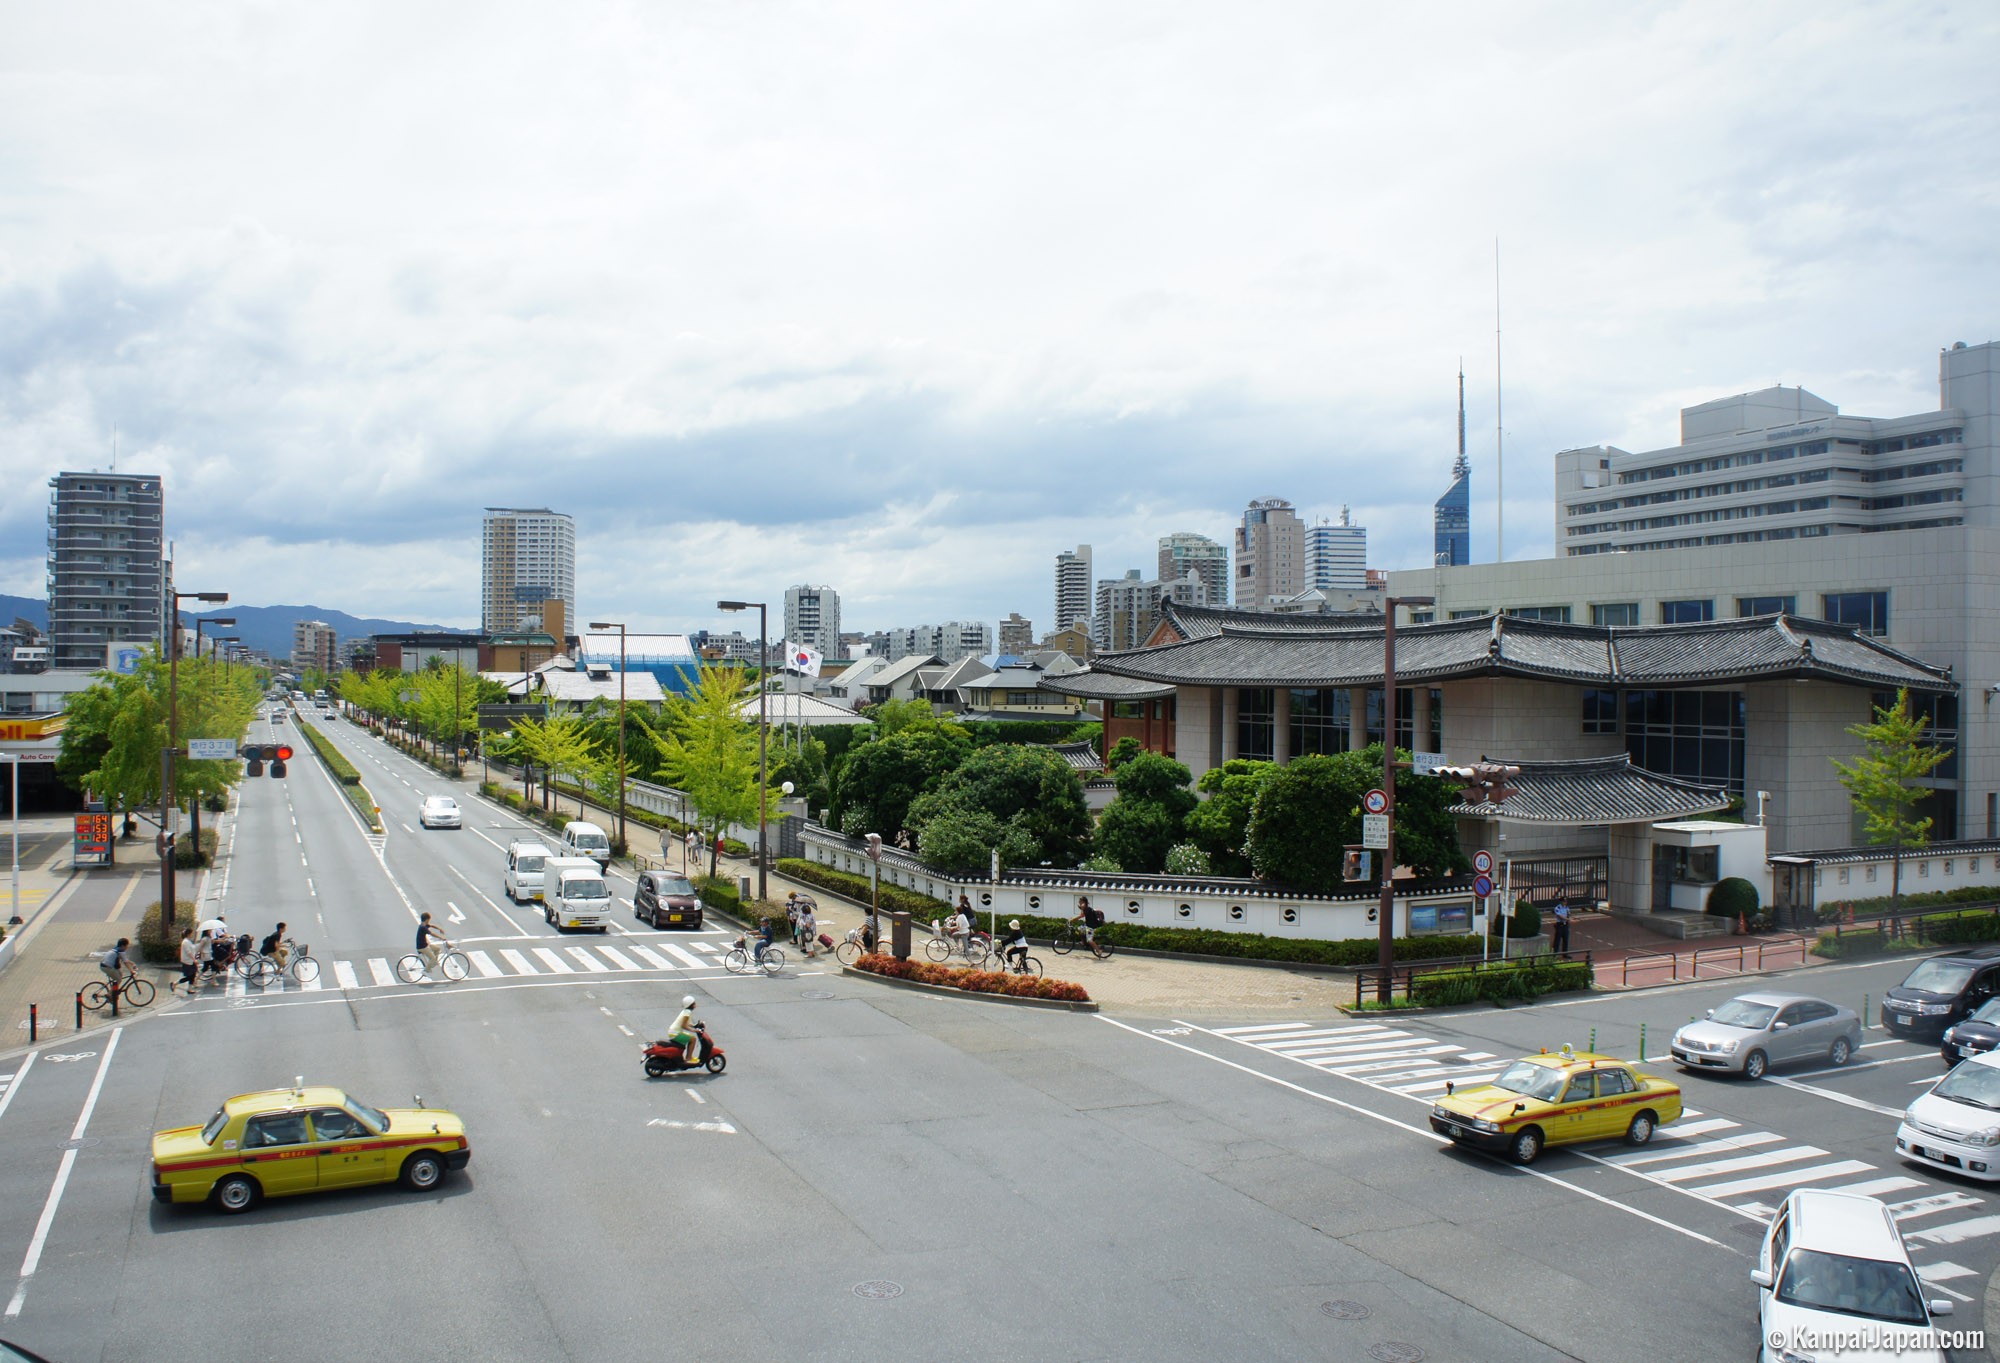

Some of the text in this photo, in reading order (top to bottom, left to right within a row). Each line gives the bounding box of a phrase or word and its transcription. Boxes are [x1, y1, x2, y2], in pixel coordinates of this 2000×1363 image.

[92, 814, 107, 823] 164
[92, 823, 107, 833] 153
[92, 833, 107, 843] 129
[1477, 857, 1489, 868] 40
